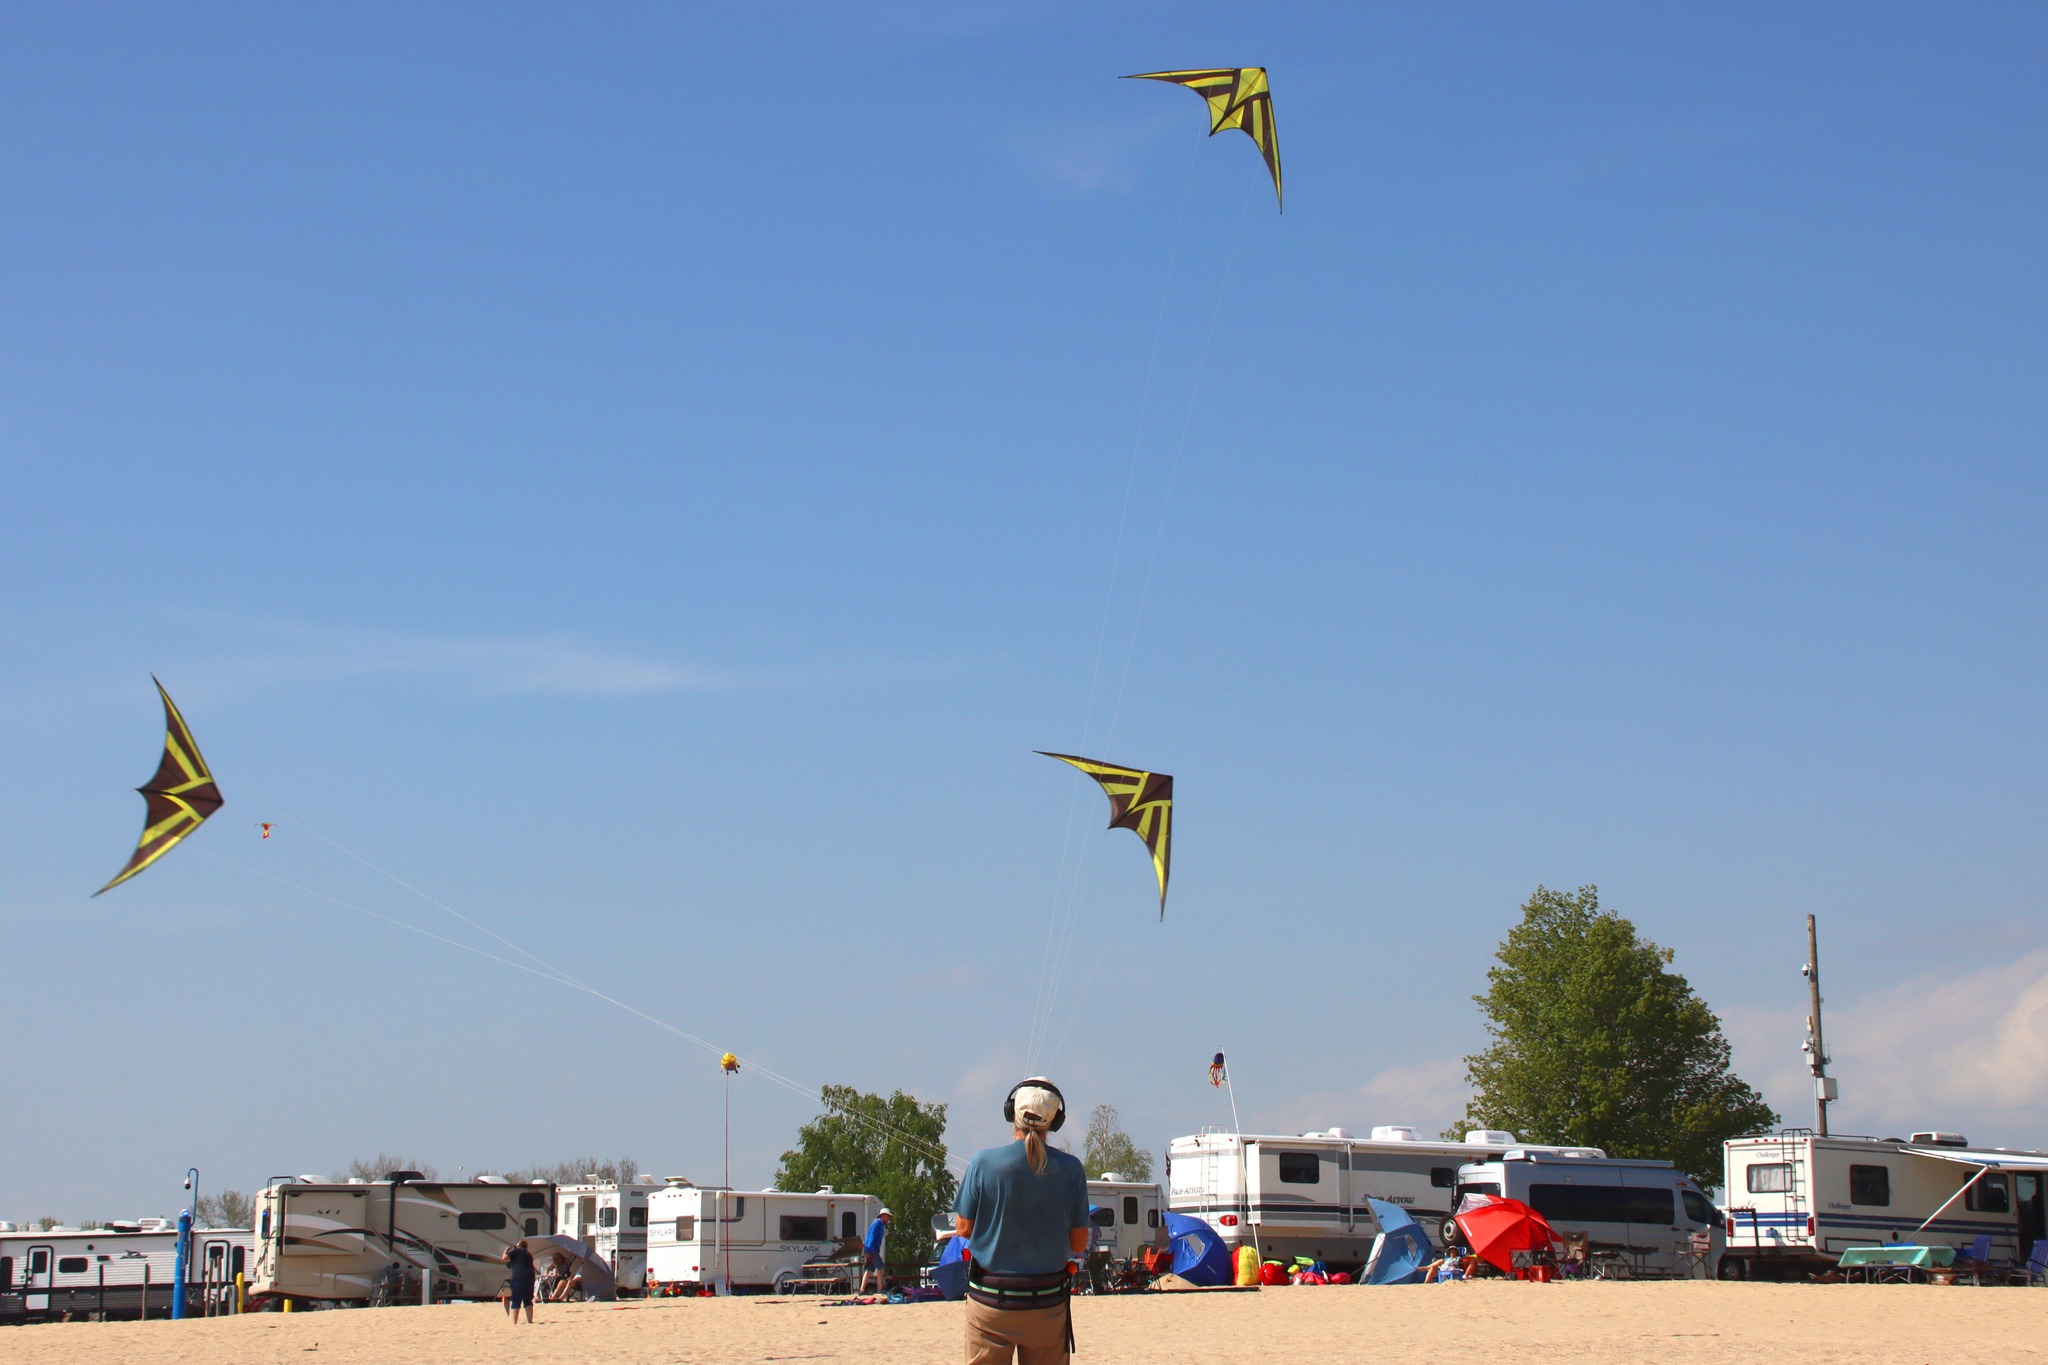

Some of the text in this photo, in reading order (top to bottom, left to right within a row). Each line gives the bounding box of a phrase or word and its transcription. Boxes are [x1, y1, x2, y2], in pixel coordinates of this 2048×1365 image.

[1386, 1194, 1416, 1204] Arrow
[649, 1229, 676, 1237] SKYLARK
[780, 1244, 820, 1253] SKYLARK
